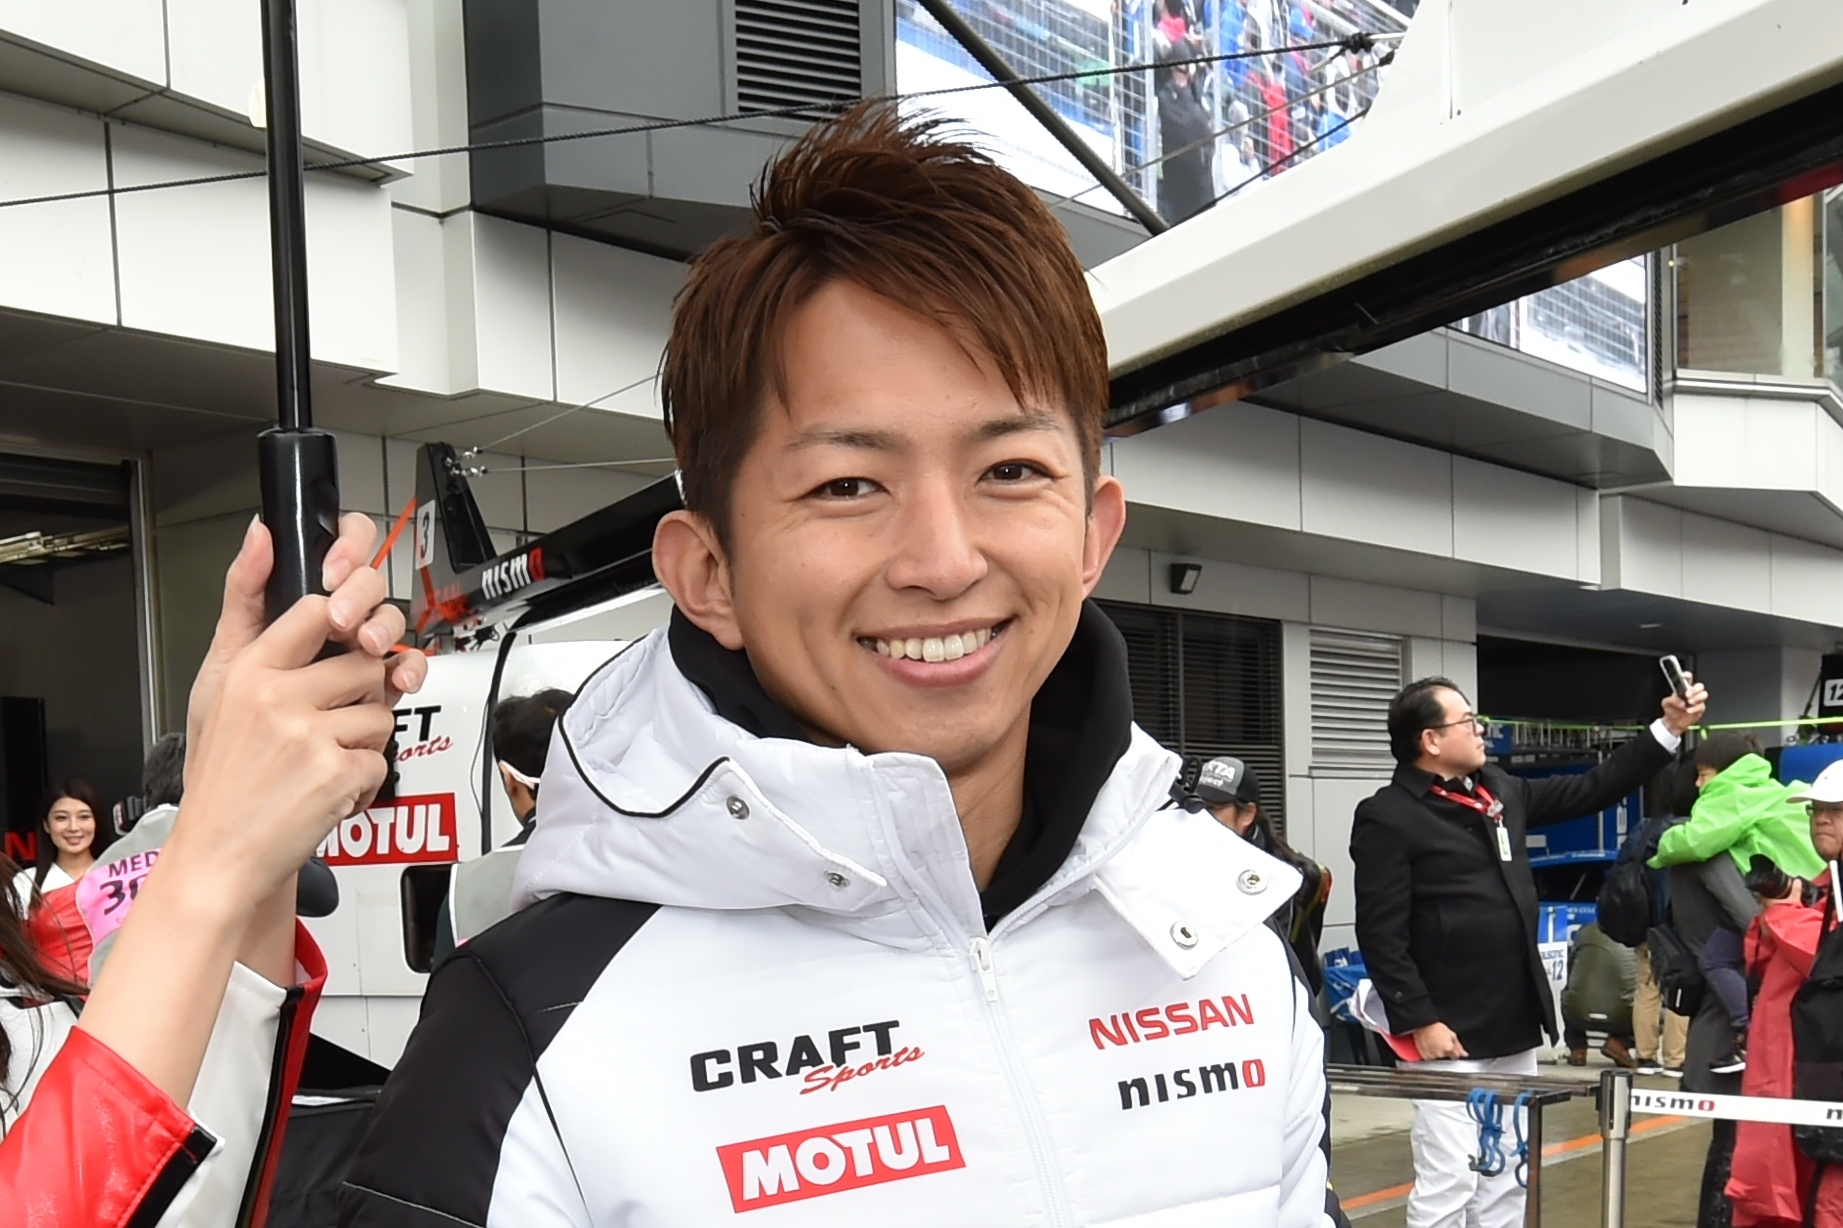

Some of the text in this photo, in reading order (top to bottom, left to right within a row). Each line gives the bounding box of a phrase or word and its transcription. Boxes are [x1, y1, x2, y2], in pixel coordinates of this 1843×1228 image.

[420, 510, 431, 560] 3
[108, 851, 160, 878] MED
[1088, 993, 1255, 1050] NISSAN
[690, 1020, 900, 1092] CRAFT
[799, 1046, 926, 1095] Sports
[1117, 1059, 1266, 1110] nismo
[742, 1117, 951, 1201] MOTUL
